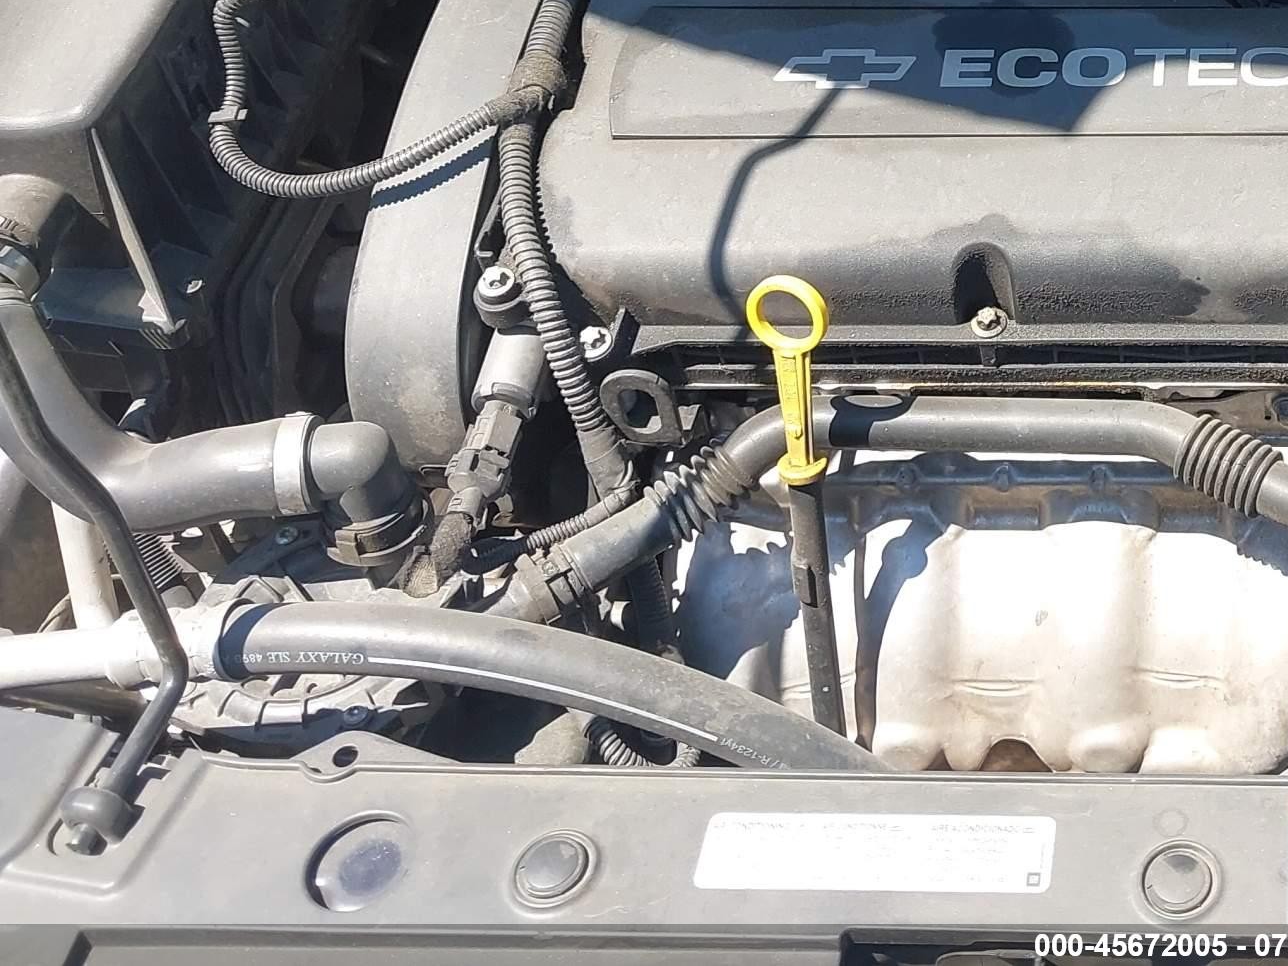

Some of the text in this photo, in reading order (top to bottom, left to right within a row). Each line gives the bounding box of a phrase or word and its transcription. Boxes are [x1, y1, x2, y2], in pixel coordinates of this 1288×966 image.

[266, 651, 291, 664] SLE
[296, 651, 364, 665] GALAXY
[720, 737, 771, 766] R-1234yf
